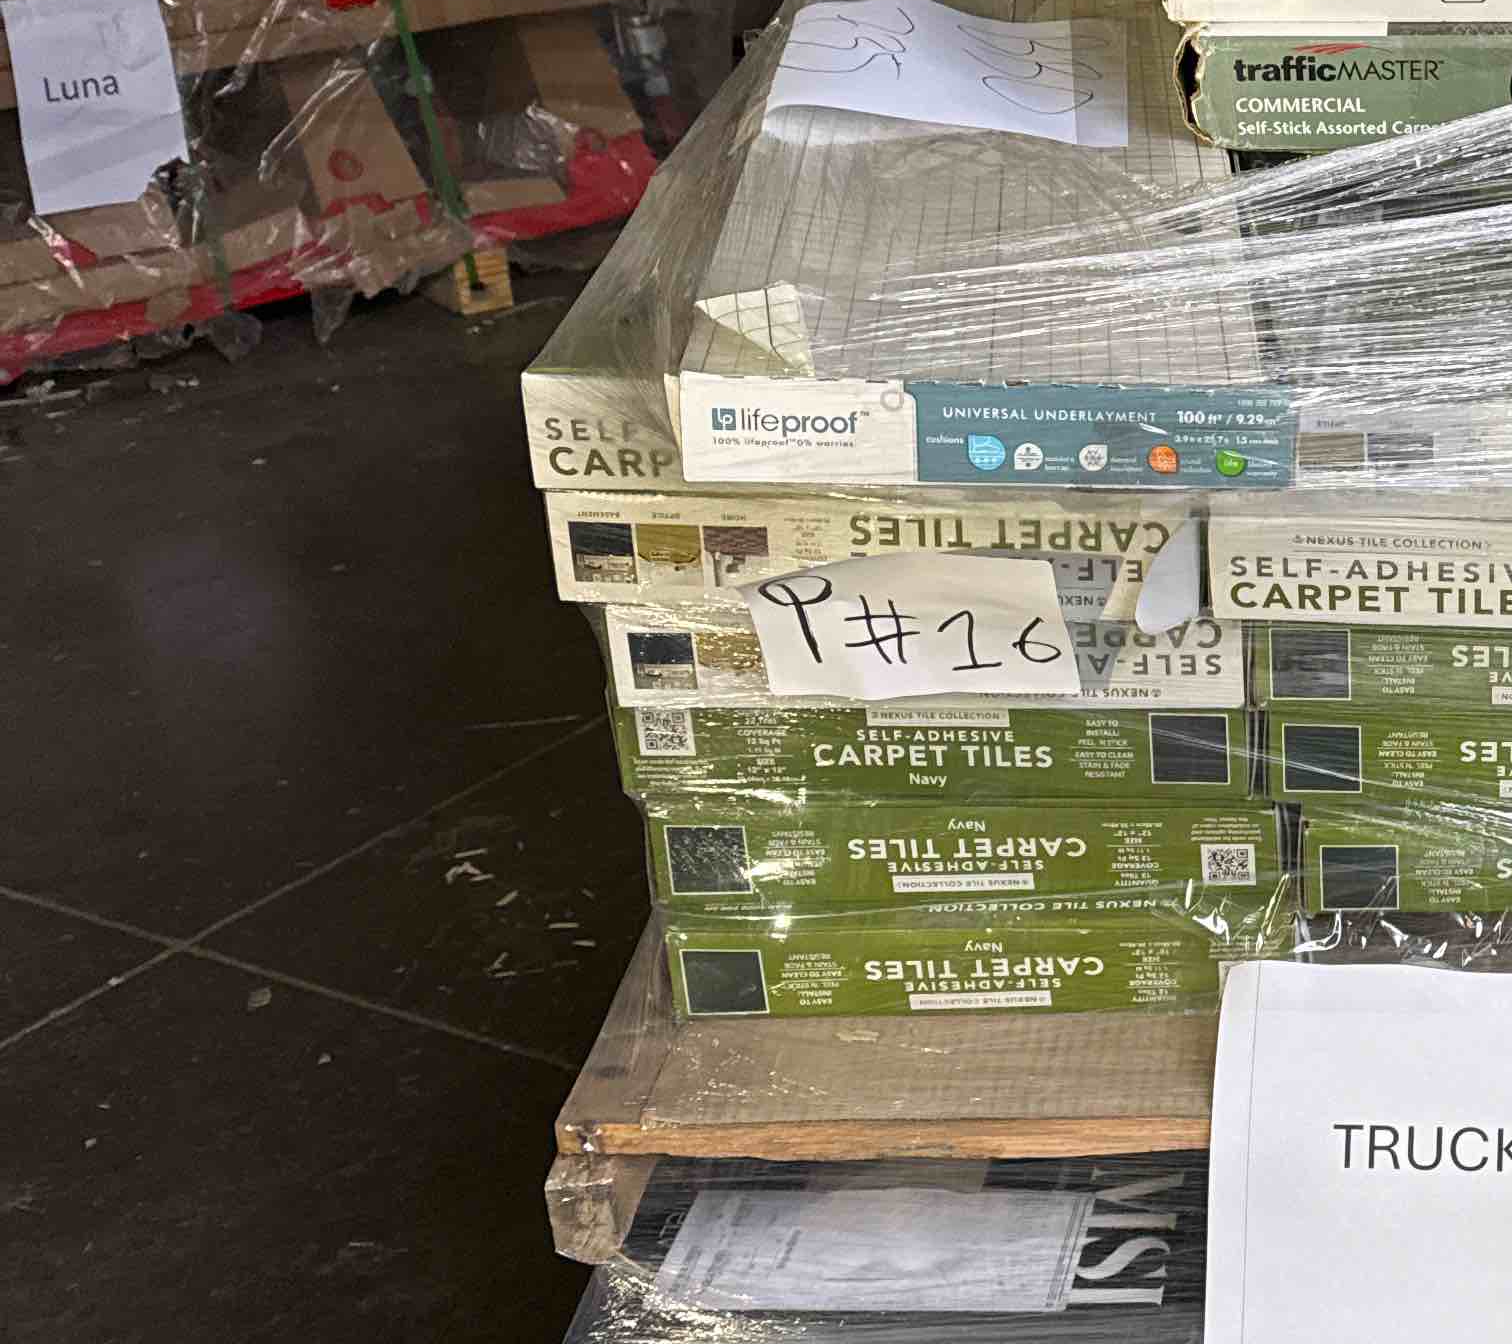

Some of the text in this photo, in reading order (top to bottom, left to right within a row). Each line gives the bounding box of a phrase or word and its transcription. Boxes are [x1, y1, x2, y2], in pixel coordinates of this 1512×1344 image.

[43, 72, 121, 104] Luna
[1235, 97, 1366, 114] COMMERCIAL
[1237, 118, 1315, 136] Self-Stick
[1319, 119, 1384, 136] Assorted
[942, 406, 1027, 422] UNIVERSAL
[1034, 408, 1157, 423] UNDERLAYMENT
[1176, 410, 1205, 425] 100
[1235, 413, 1264, 426] 9.29
[550, 446, 675, 478] CARP
[850, 513, 1171, 553] CARPET TILES
[1304, 536, 1483, 551] NEXUS TILE COLLECTION
[1230, 581, 1418, 614] CARPET
[879, 711, 1002, 722] NEXUS TILE COLLECTION
[856, 729, 1015, 744] SELF-ADHESIVE
[813, 743, 1054, 768] CARPET TILES
[908, 772, 948, 788] Navy
[947, 818, 987, 834] Navy
[847, 837, 1087, 860] CARPET TILES
[886, 859, 1045, 874] SELF-ADHESIVE
[1053, 899, 1089, 914] TILE
[1095, 898, 1157, 913] NEXUS
[964, 940, 1003, 955] Navy
[863, 956, 1105, 982] CARPET TILES
[903, 977, 1062, 992] SELF-ADHESIVE
